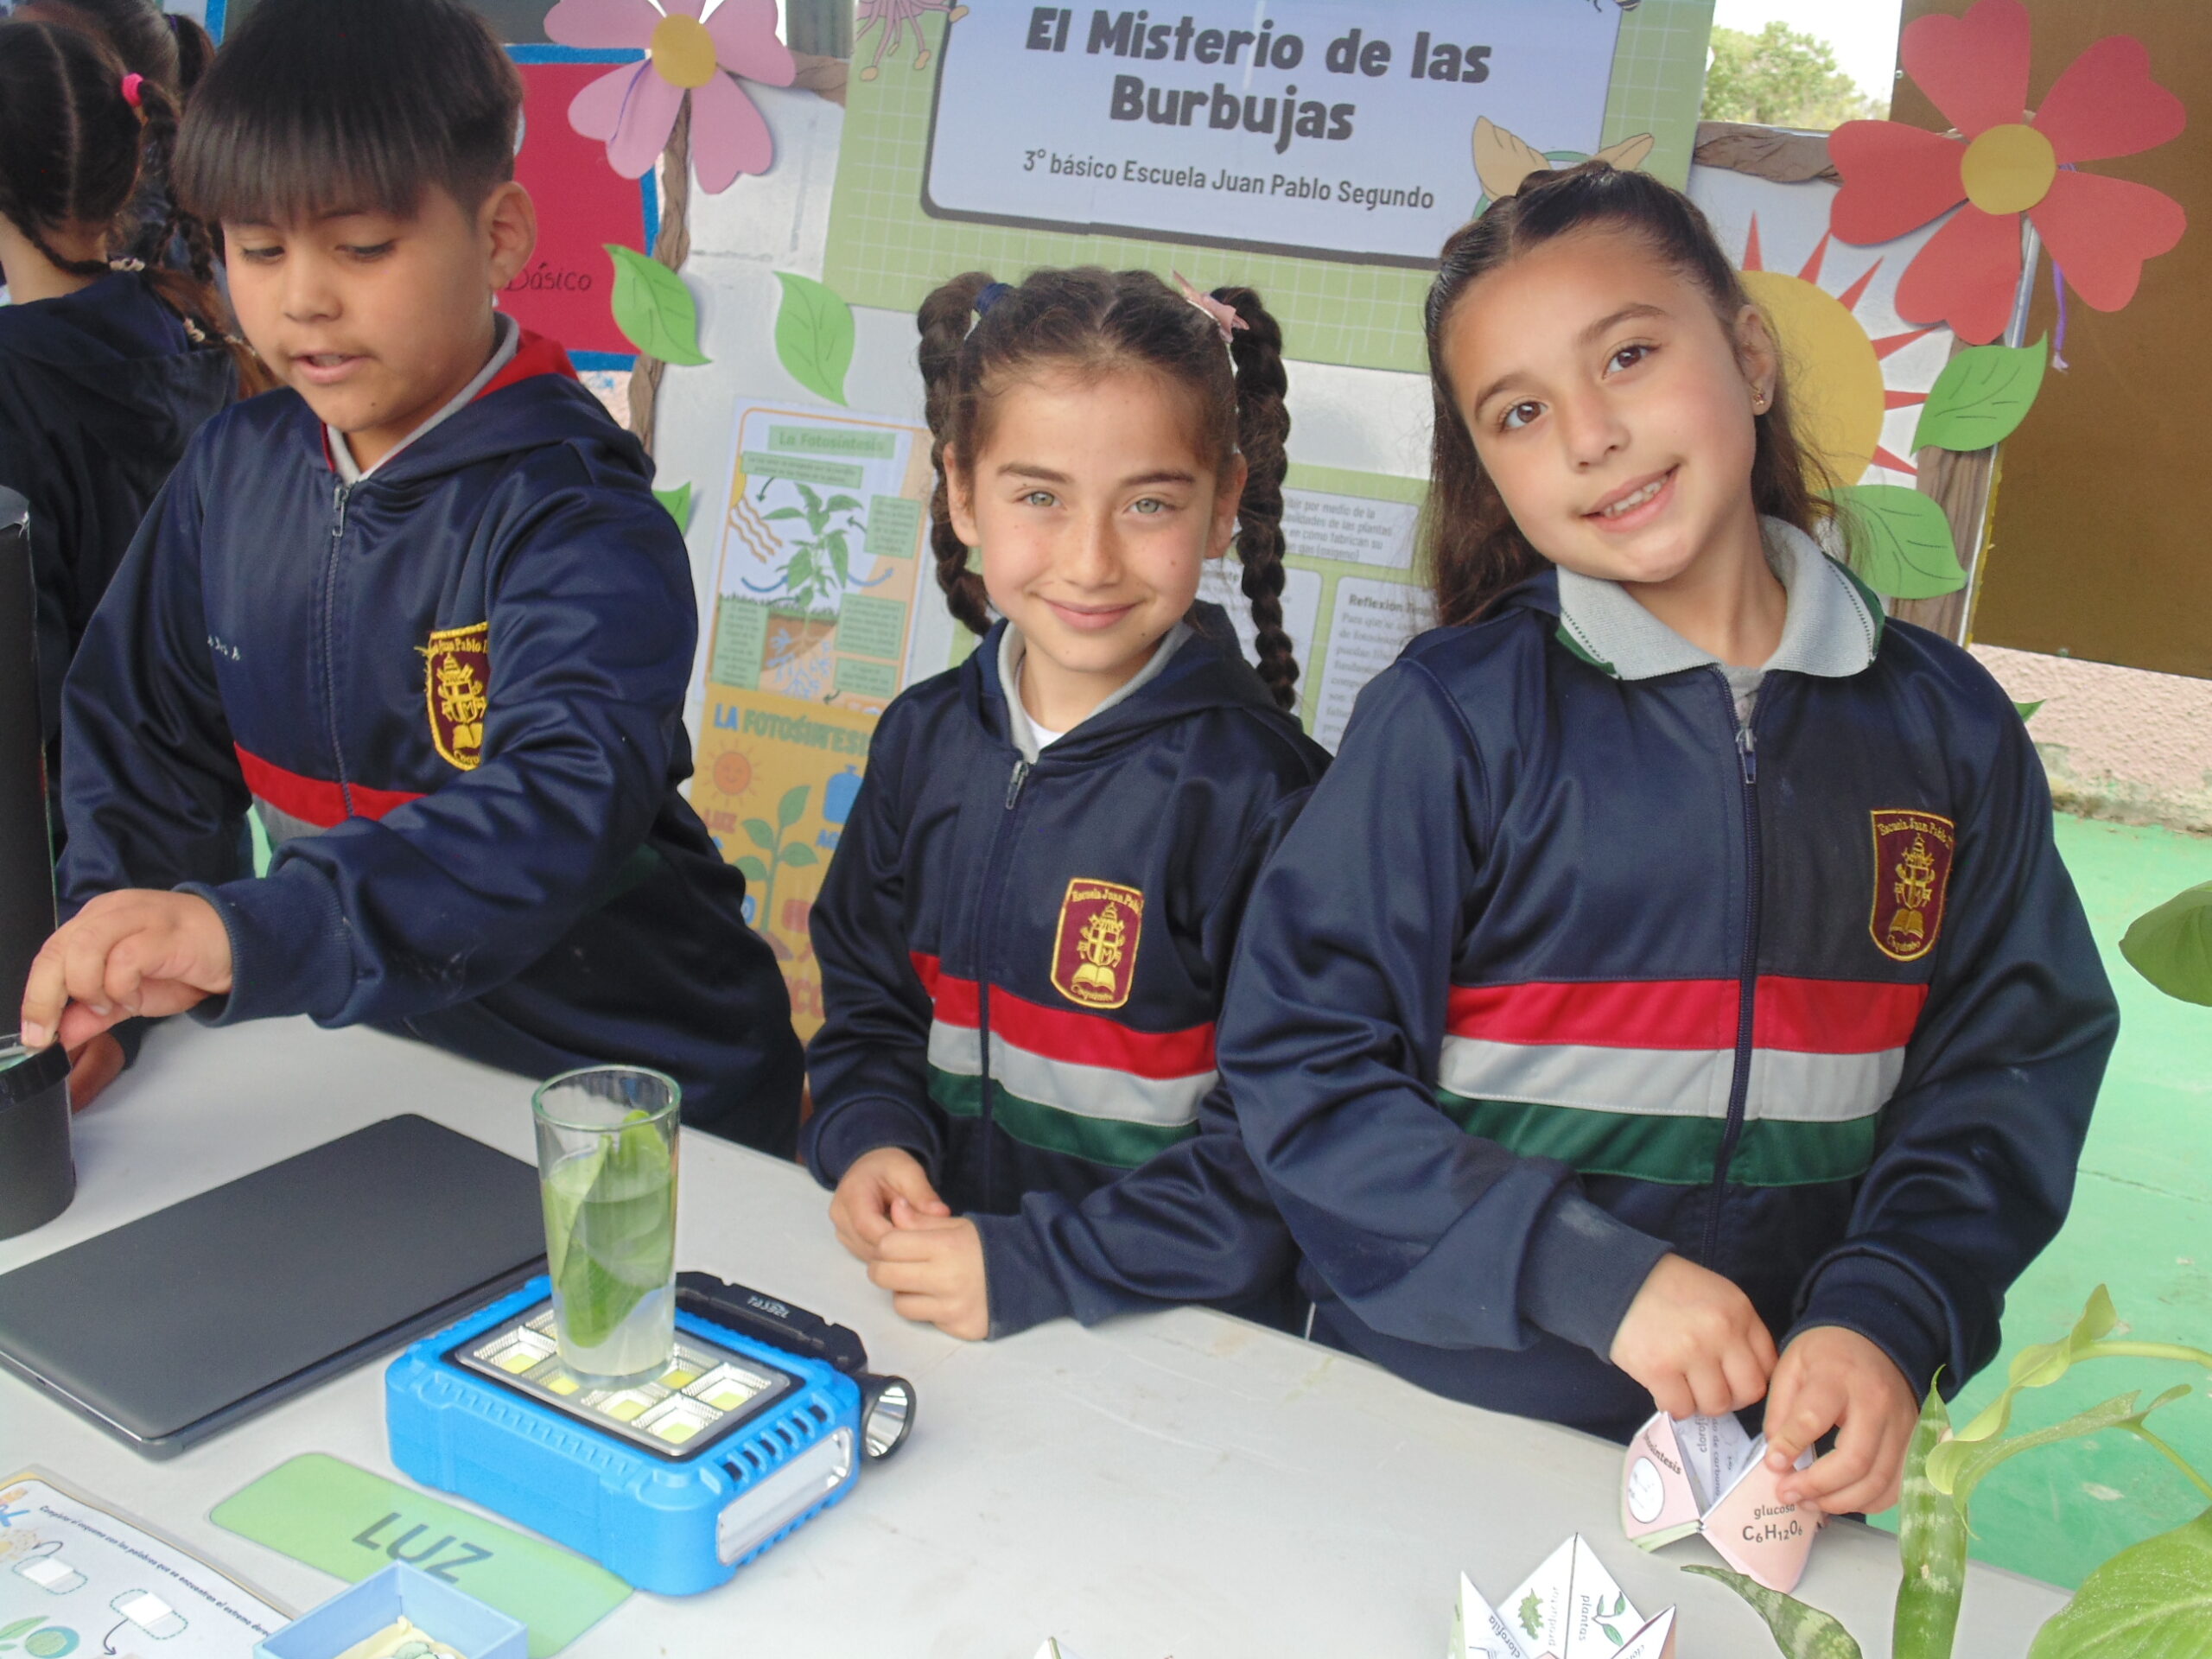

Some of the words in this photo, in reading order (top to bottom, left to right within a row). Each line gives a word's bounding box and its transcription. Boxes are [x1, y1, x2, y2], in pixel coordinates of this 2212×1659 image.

[1026, 7, 1072, 52] El
[1086, 10, 1304, 70] Misterio
[1325, 29, 1391, 77] de
[1410, 31, 1492, 83] las
[1109, 74, 1356, 153] Burbujas
[1049, 153, 1117, 180] básico
[1122, 160, 1206, 188] Escuela
[1211, 168, 1265, 194] Juan
[1271, 174, 1332, 201] Pablo
[1338, 180, 1434, 211] Segundo
[715, 703, 738, 731] LA
[743, 709, 868, 758] FOTOSÍNTESI
[1754, 1503, 1796, 1520] glucosa
[352, 1512, 494, 1585] LUZ
[1489, 1616, 1521, 1658] clorofila
[1579, 1594, 1592, 1641] plantas
